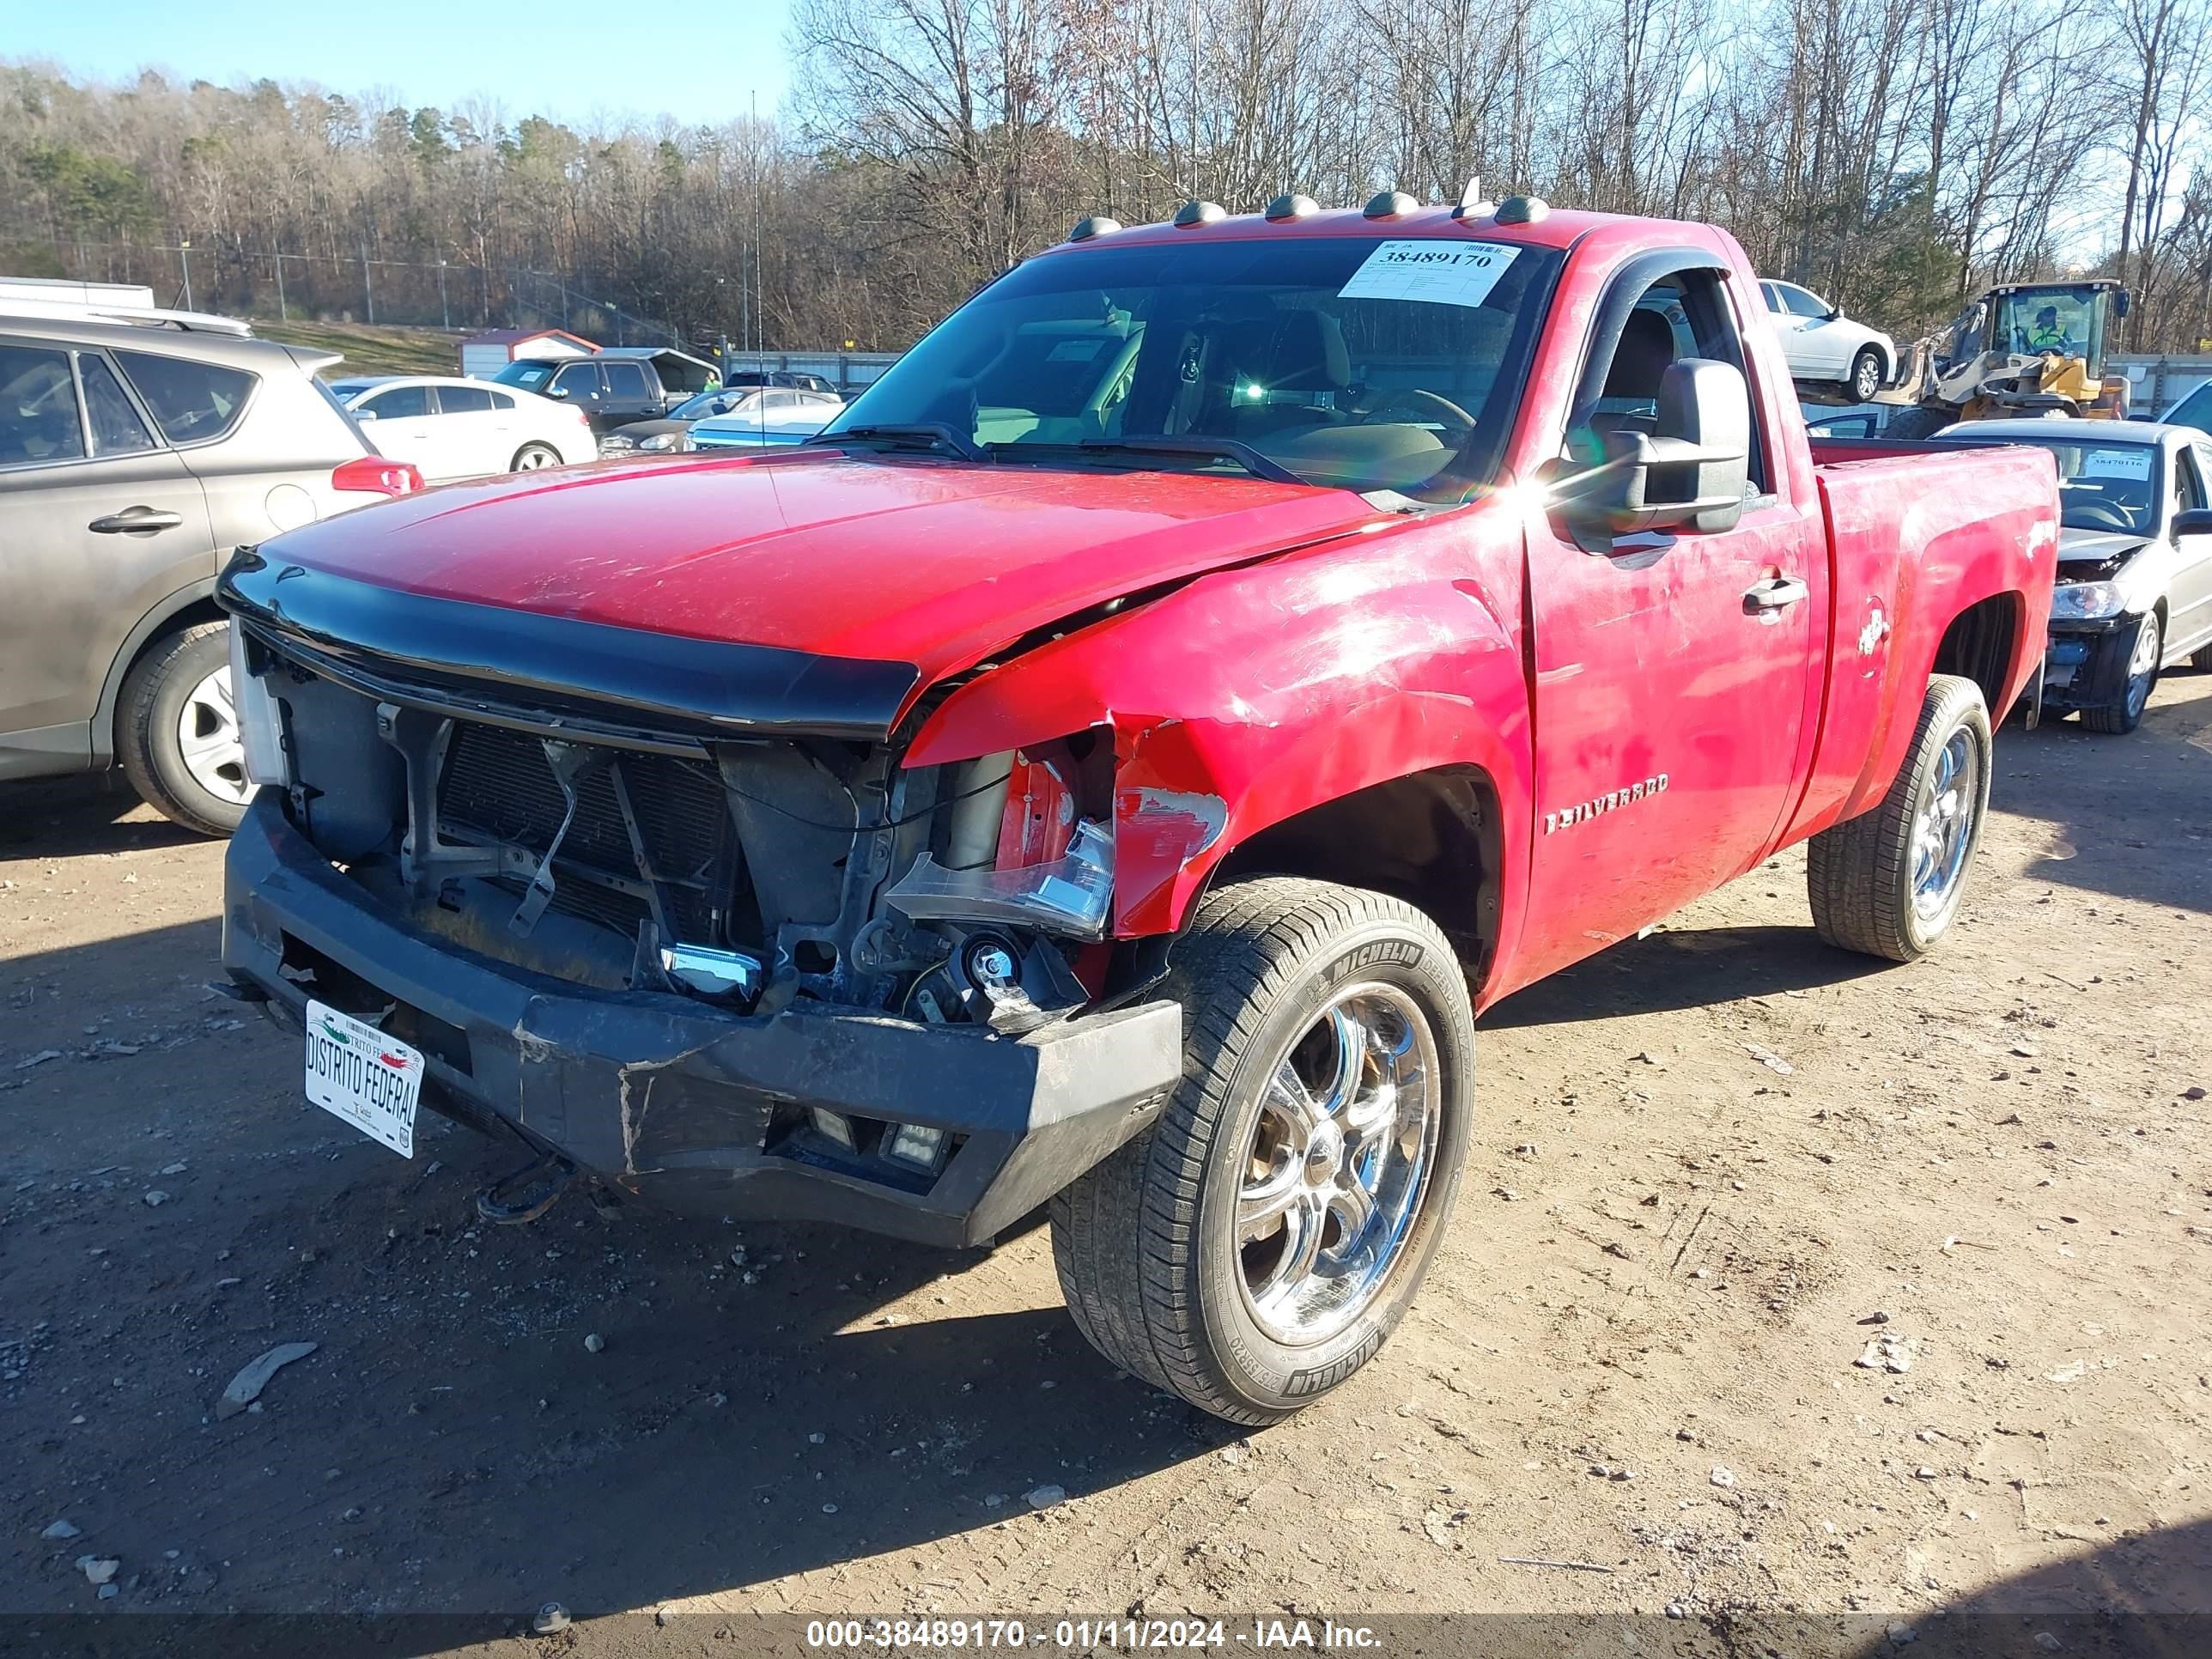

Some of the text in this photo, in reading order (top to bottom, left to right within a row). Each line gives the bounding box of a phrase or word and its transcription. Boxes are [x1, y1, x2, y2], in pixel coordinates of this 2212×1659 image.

[1379, 252, 1492, 268] 38489170
[1559, 773, 1669, 830] SILVERADO
[1333, 942, 1421, 983] MICHELIN
[1424, 958, 1462, 1018] DEFENDER
[307, 1031, 415, 1128] DISTRITO FEDERAL
[1230, 1336, 1280, 1389] 275/55R20
[1287, 1331, 1379, 1395] MICHELIN
